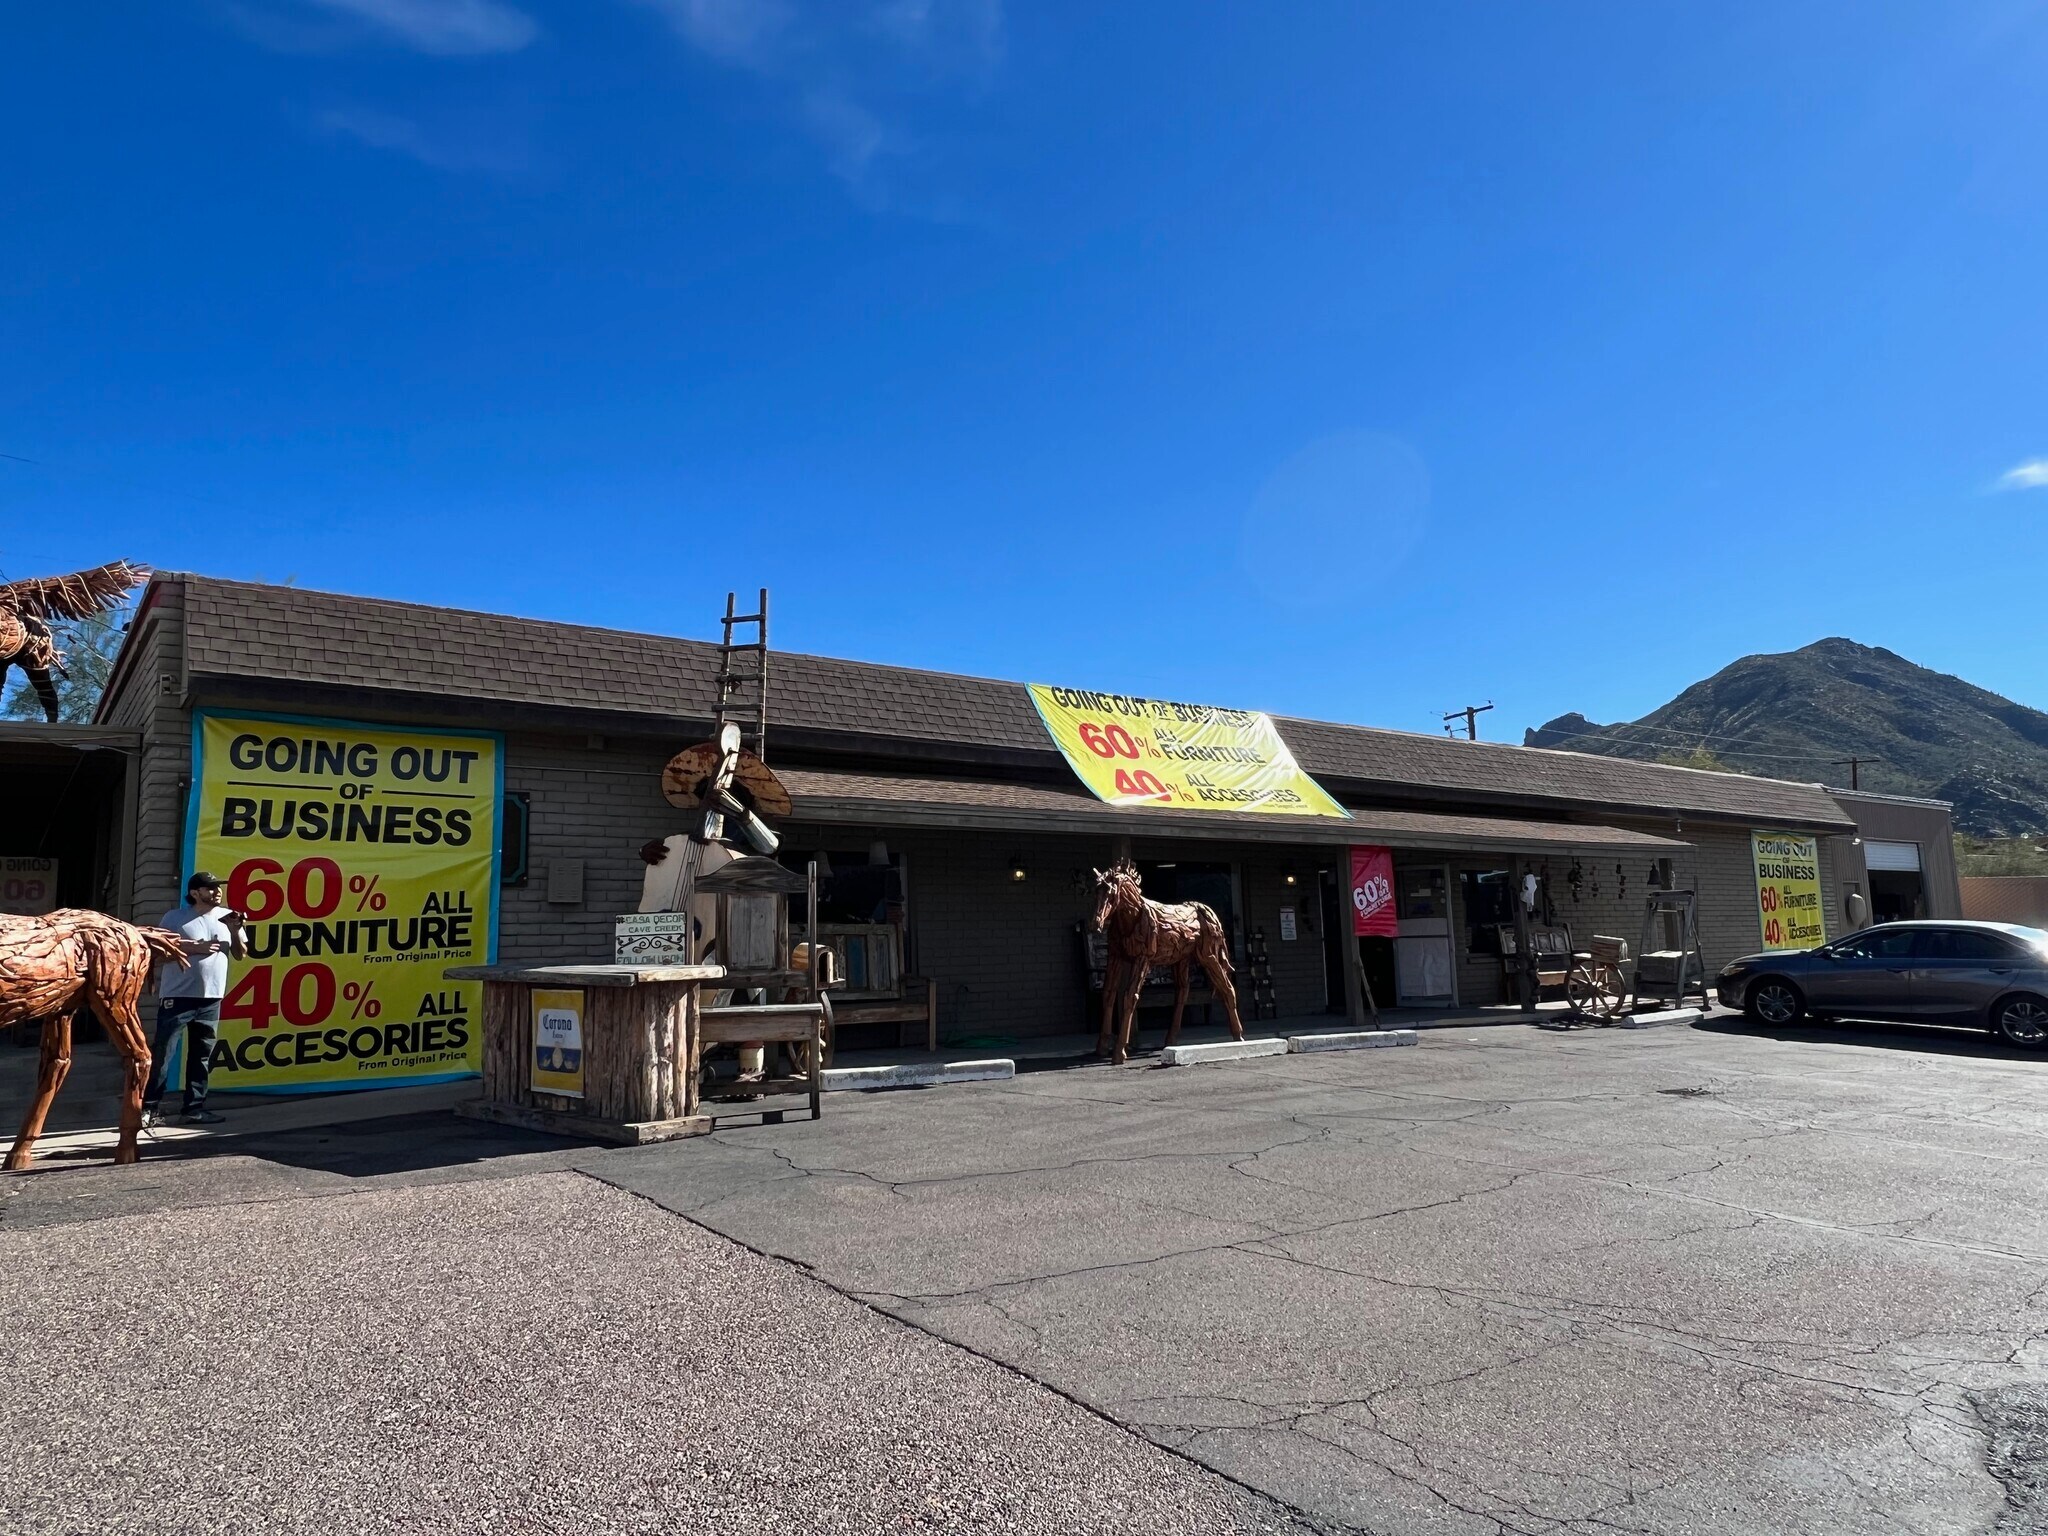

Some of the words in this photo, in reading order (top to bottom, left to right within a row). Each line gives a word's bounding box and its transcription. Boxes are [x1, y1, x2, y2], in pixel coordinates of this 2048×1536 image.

[1051, 686, 1113, 714] GOING
[1112, 695, 1151, 718] OUT
[1079, 723, 1161, 759] 60%
[1160, 743, 1267, 763] FURNITURE
[229, 734, 378, 778] GOING
[390, 746, 479, 784] OUT
[339, 783, 374, 800] OF
[1115, 769, 1195, 802] 40%
[1185, 774, 1215, 787] ALL
[220, 797, 472, 846] BUSINESS
[1758, 840, 1790, 856] GOING
[1759, 863, 1814, 880] BUSINESS
[226, 857, 387, 922] 60%
[422, 891, 472, 915] ALL
[1353, 873, 1388, 910] 60%
[625, 915, 651, 924] CASA
[653, 914, 686, 925] DECOR
[246, 915, 472, 959] URNITURE
[363, 953, 392, 964] From
[396, 949, 440, 964] Original
[444, 949, 472, 960] Price
[220, 962, 382, 1030] 40%
[417, 990, 467, 1017] ALL
[543, 1014, 572, 1030] Corona
[207, 1017, 469, 1074] ACCESORIES
[358, 1059, 388, 1071] From
[391, 1055, 436, 1069] Original
[439, 1051, 467, 1062] Price
